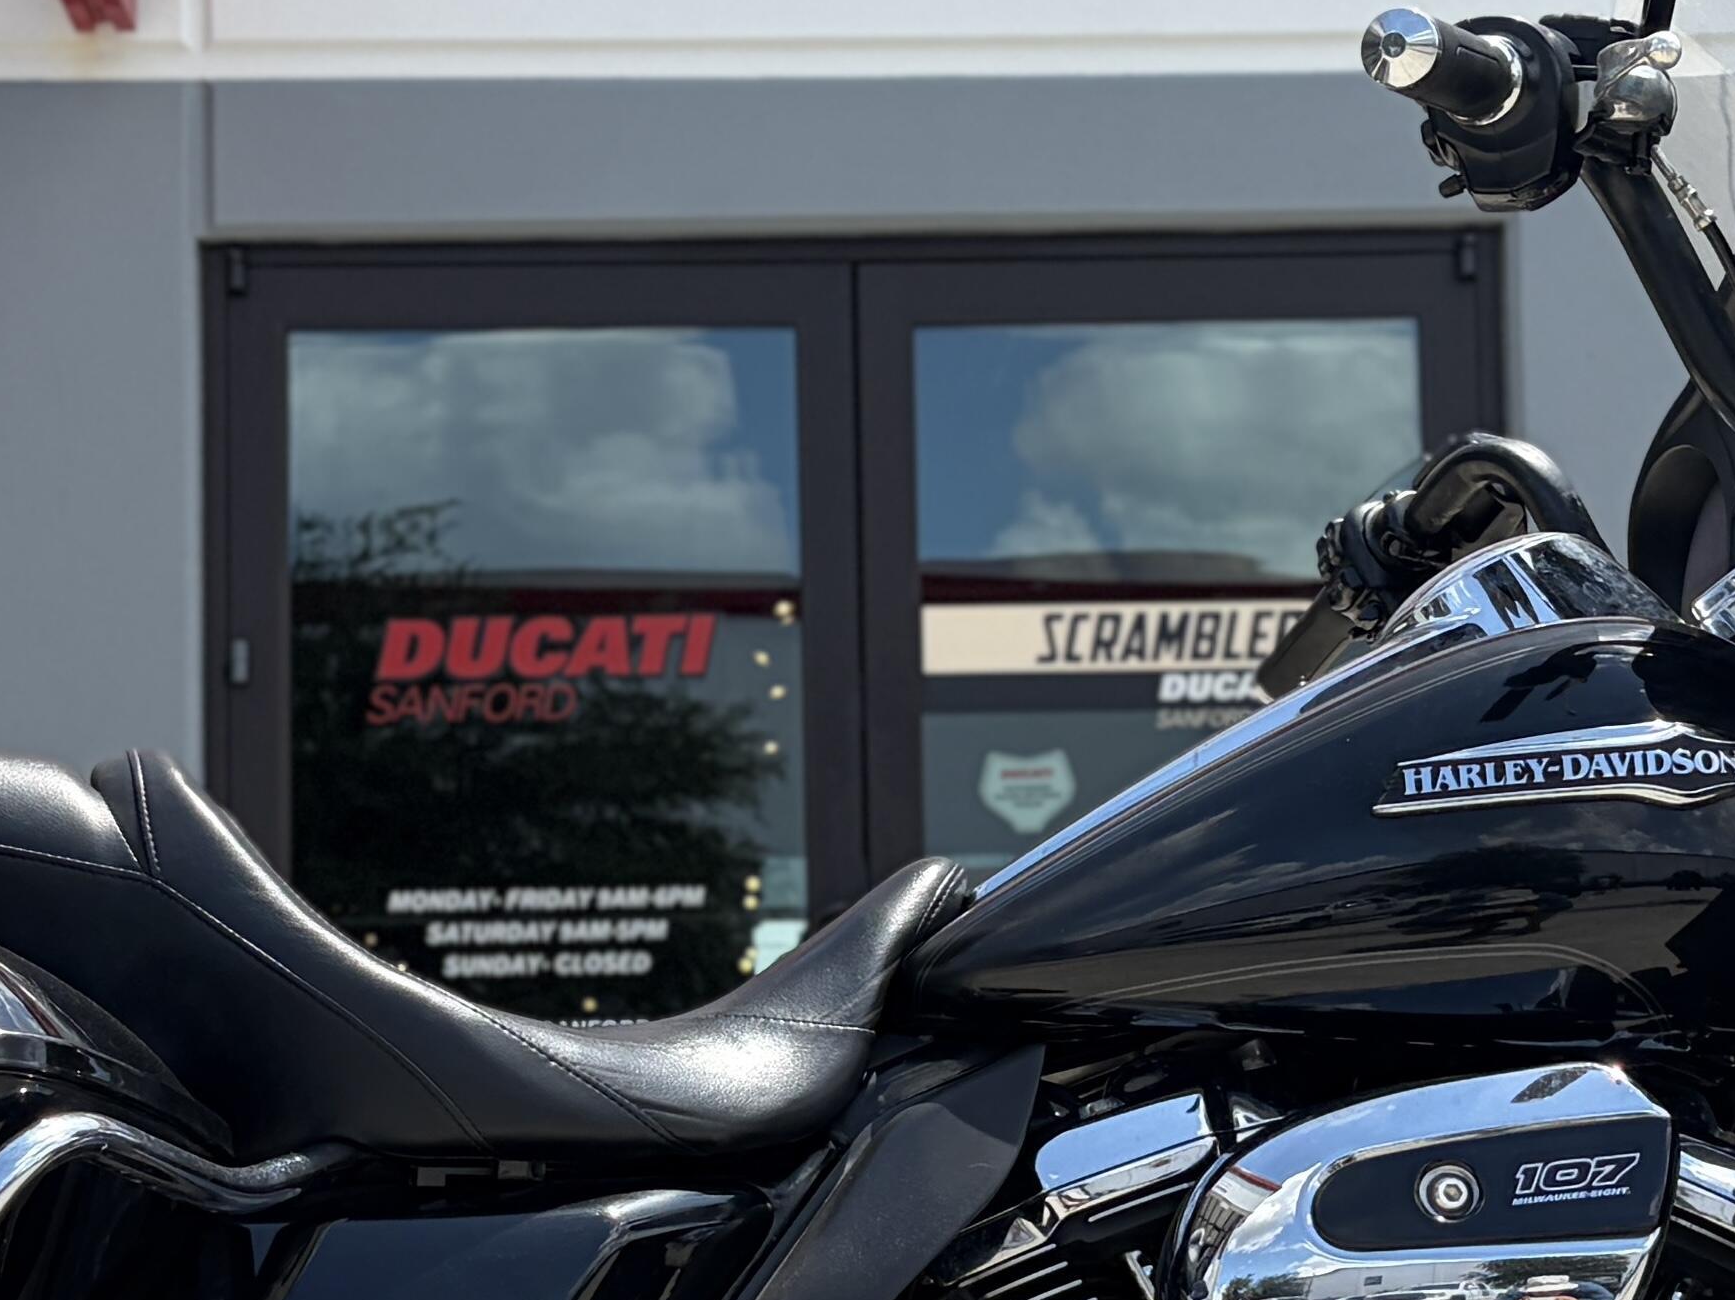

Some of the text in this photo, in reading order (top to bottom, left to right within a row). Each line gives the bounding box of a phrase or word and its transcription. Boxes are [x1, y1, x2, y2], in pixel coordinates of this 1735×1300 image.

[375, 613, 718, 680] DUCATI
[365, 683, 580, 724] SANFORD
[505, 885, 594, 911] FRIDAY
[425, 919, 556, 947] SATURDAY
[552, 950, 653, 976] CLOSED
[1514, 1151, 1641, 1195] 107
